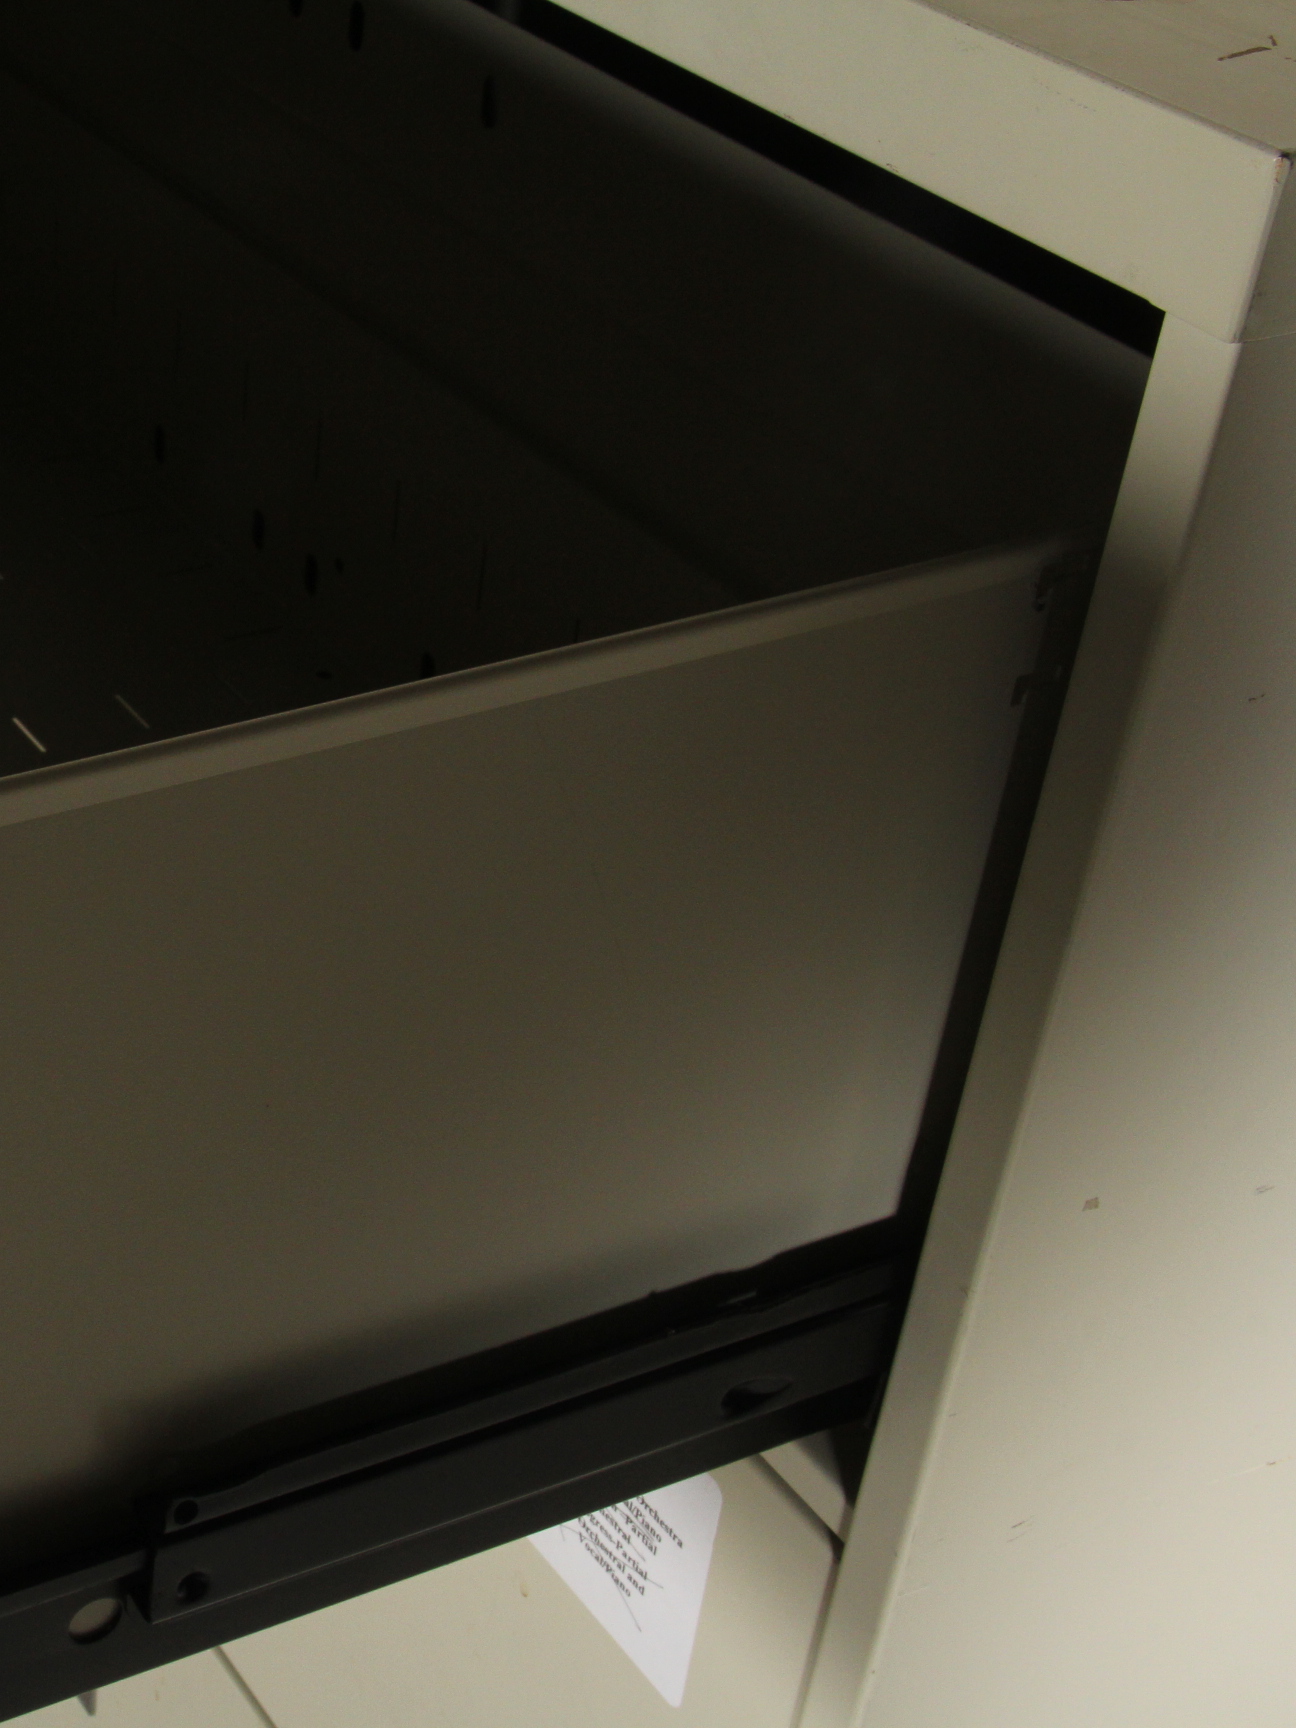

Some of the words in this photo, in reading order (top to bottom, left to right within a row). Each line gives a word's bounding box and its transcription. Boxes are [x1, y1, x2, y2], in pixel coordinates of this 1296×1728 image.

[586, 1514, 648, 1581] gress-Partial
[636, 1496, 683, 1549] Orchestra
[578, 1517, 626, 1574] Orchestral
[627, 1572, 645, 1596] and
[578, 1532, 631, 1598] Vocal/Piano
